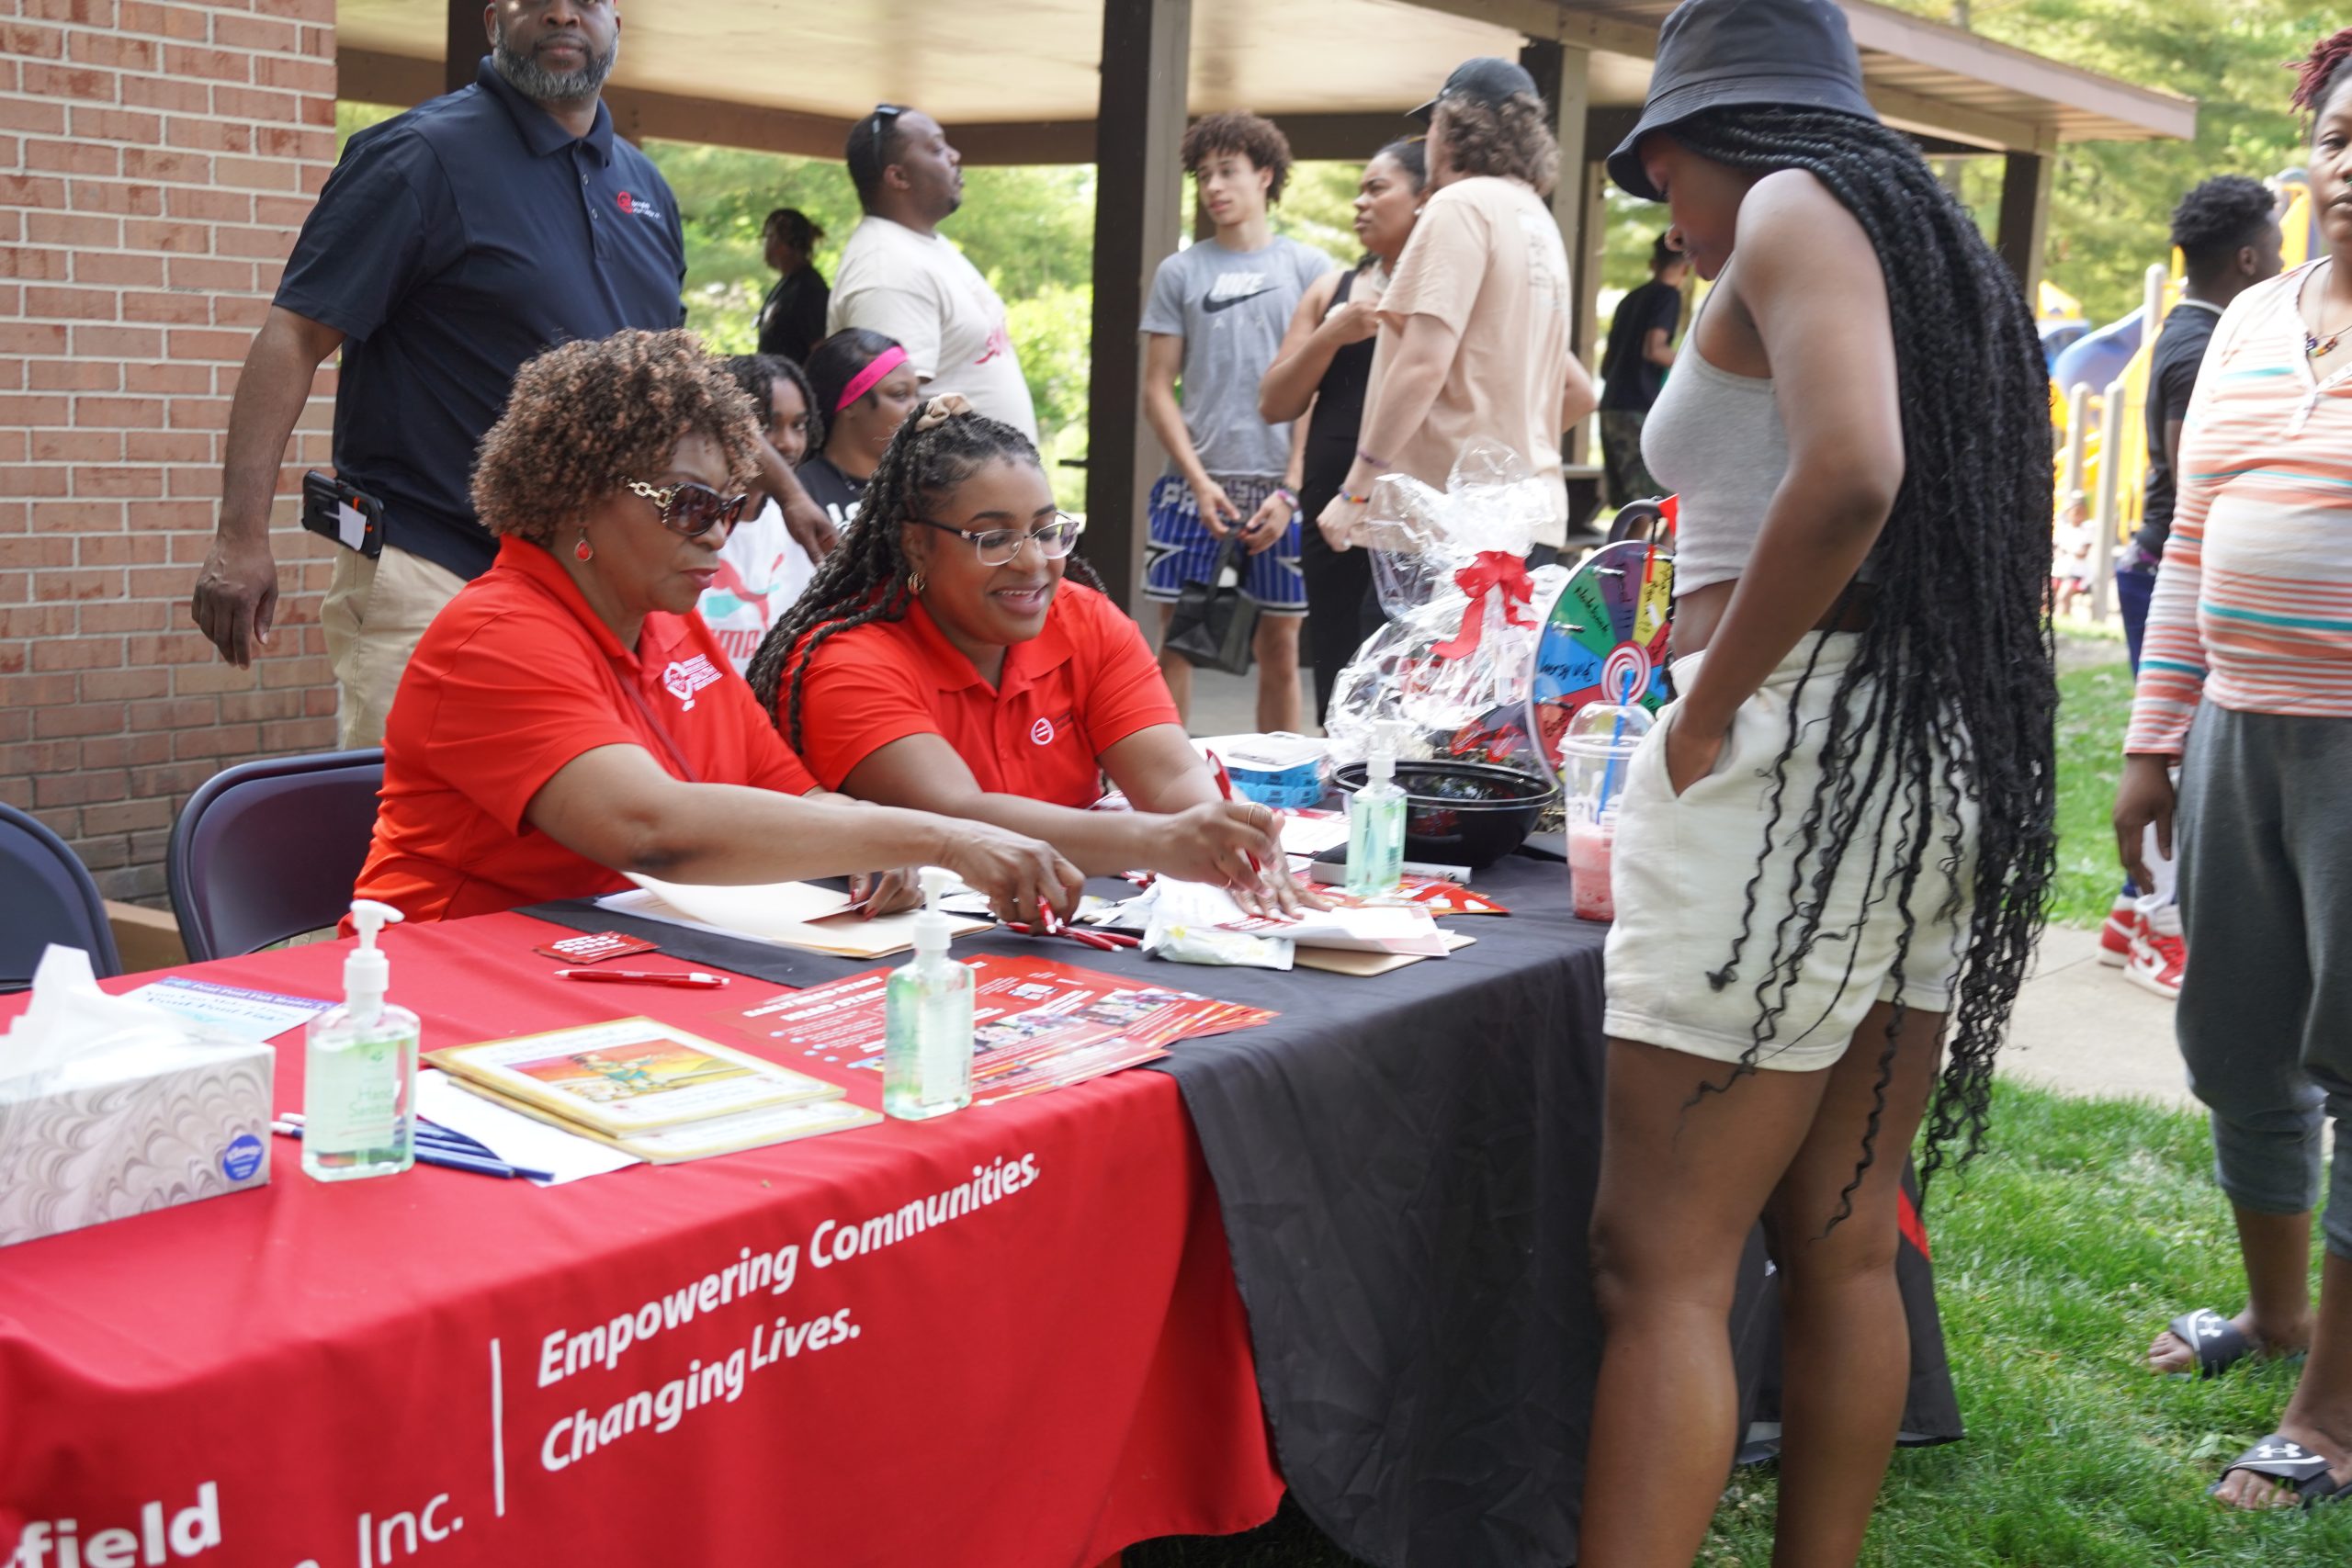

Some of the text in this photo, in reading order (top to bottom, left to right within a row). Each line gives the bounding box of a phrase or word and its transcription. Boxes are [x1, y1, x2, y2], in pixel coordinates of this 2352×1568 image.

[537, 1244, 800, 1388] Empowering
[540, 1307, 861, 1472] Changing Lives.
[0, 1480, 221, 1568] field
[357, 1493, 464, 1568] Inc.
